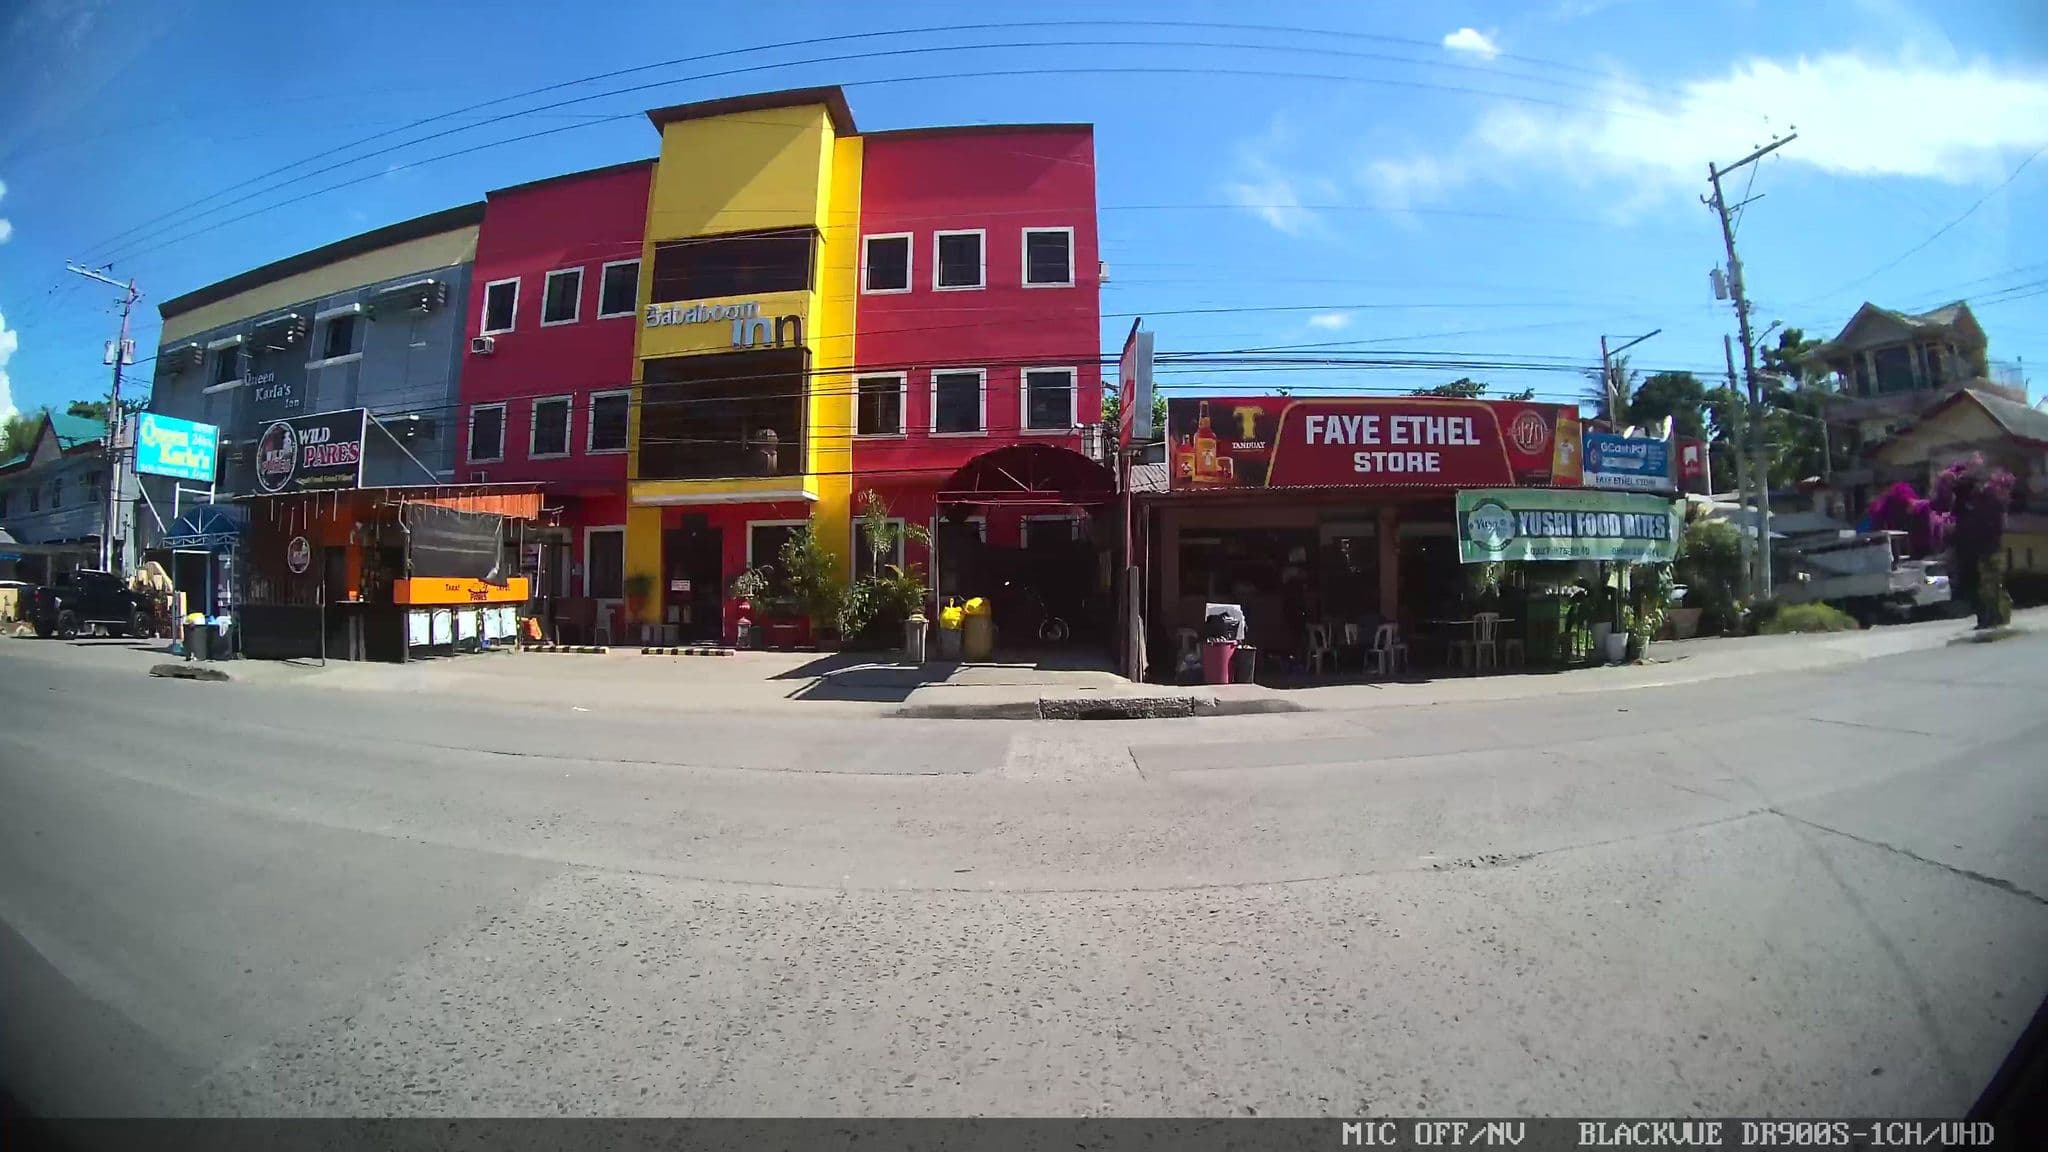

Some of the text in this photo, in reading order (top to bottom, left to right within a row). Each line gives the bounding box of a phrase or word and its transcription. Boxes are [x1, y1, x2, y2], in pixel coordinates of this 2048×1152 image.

[255, 384, 291, 402] Karla's
[298, 427, 331, 445] WILD
[1305, 415, 1481, 445] FAYE ETHEL
[303, 440, 360, 468] PARES
[1231, 441, 1266, 449] TANDUAY
[1353, 452, 1440, 473] STORE
[1519, 511, 1666, 539] YUSRI FOOD BITES
